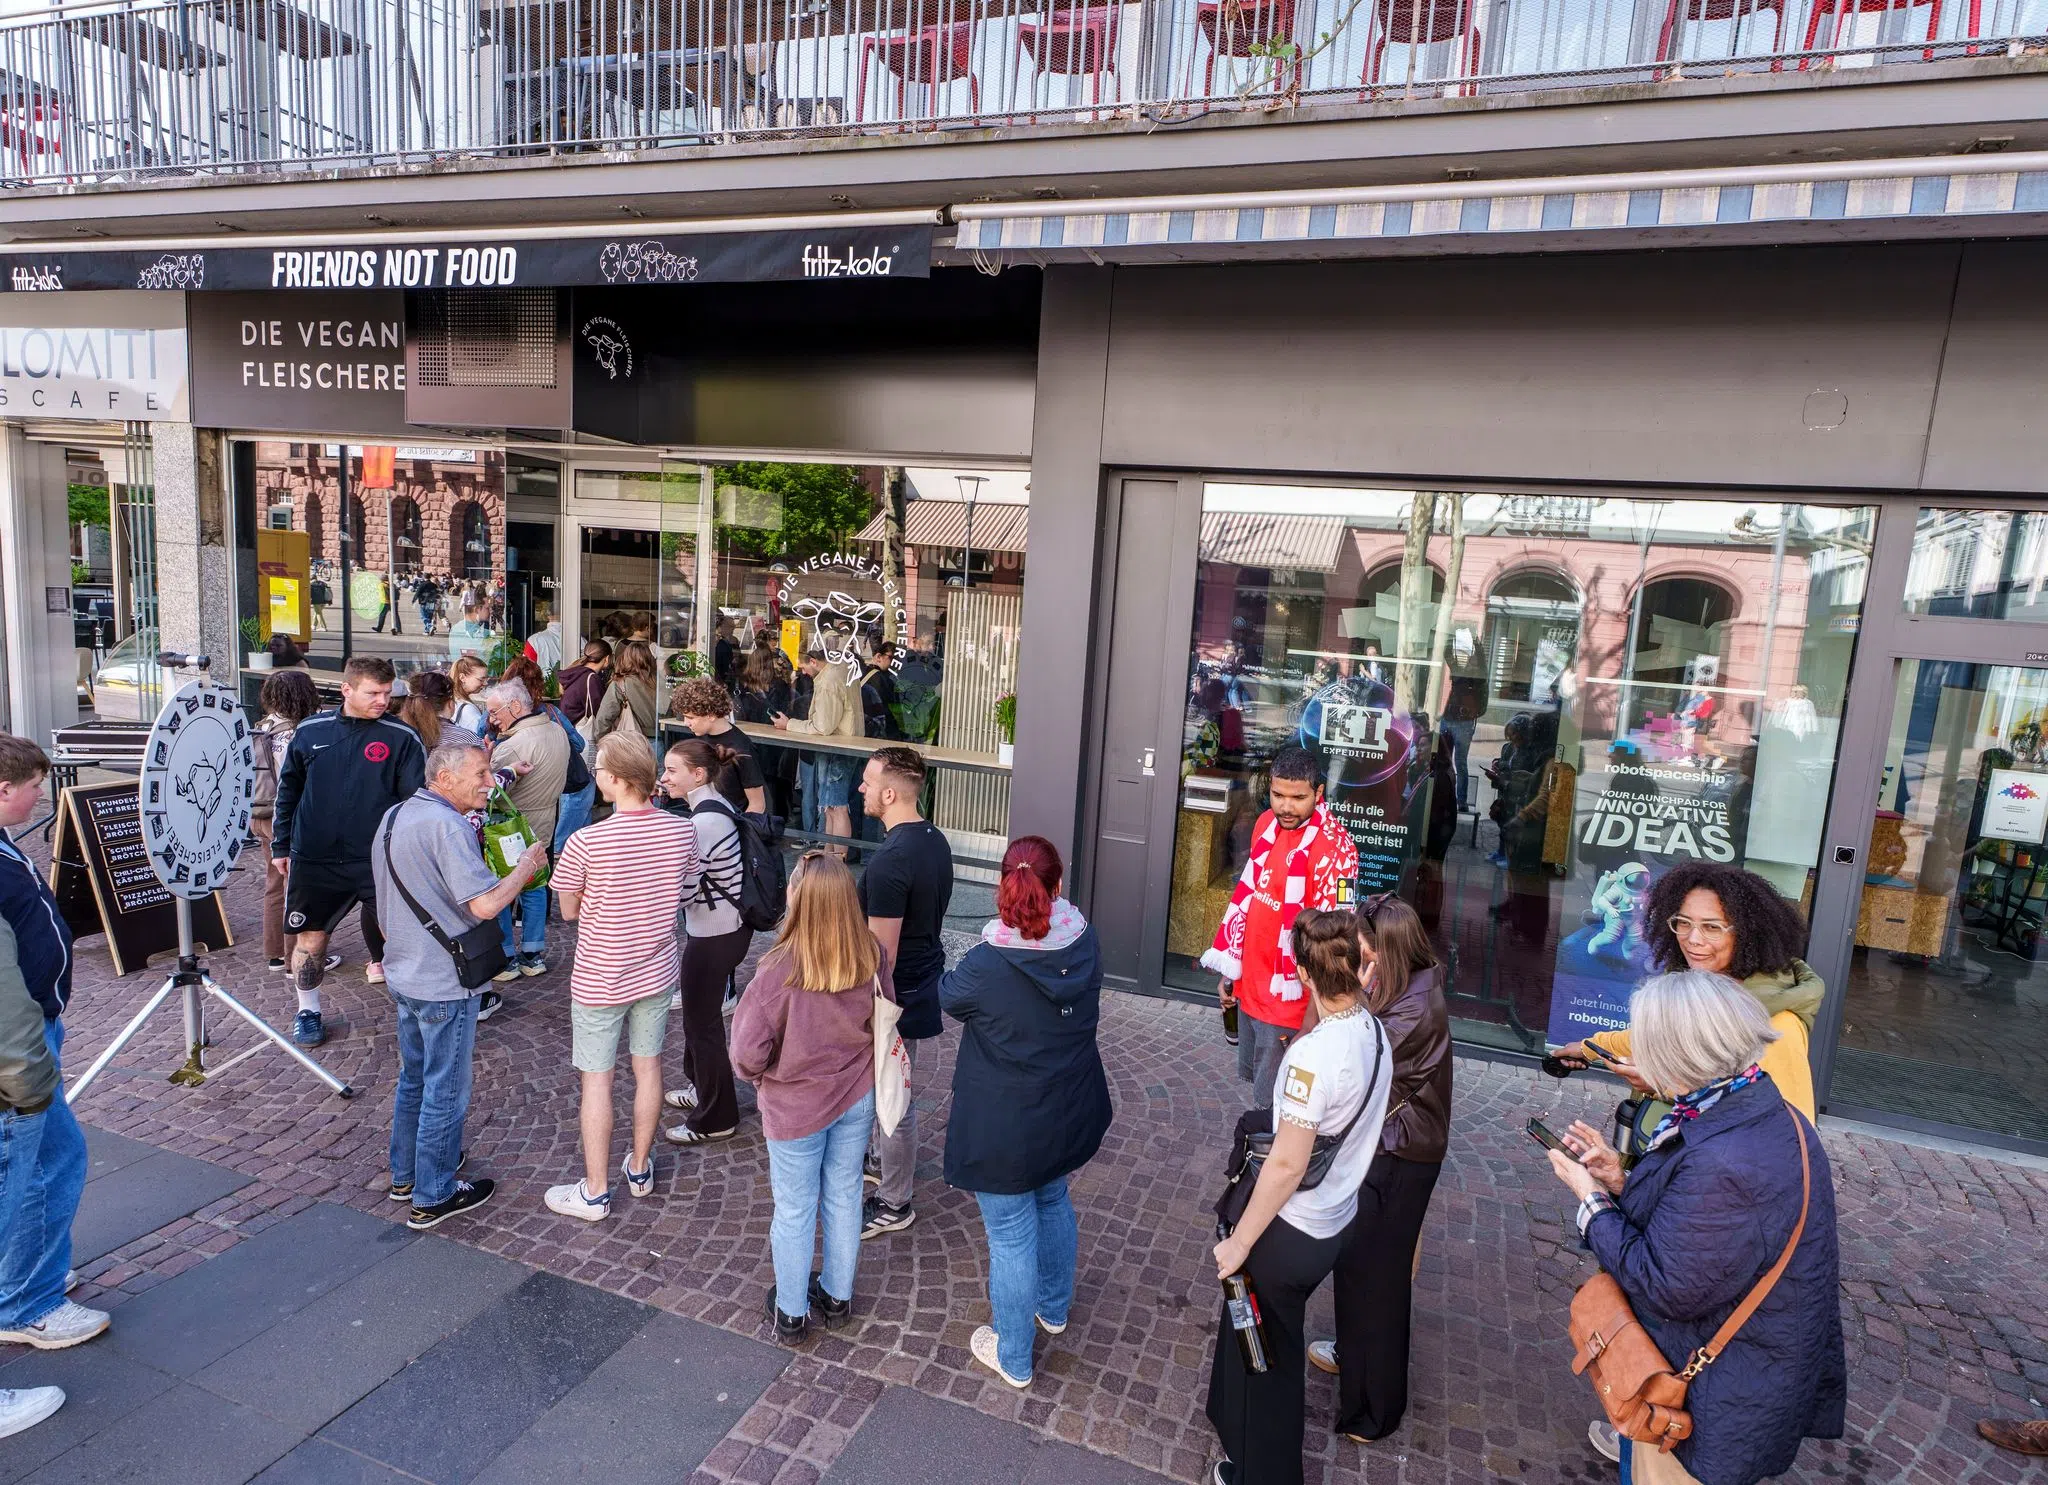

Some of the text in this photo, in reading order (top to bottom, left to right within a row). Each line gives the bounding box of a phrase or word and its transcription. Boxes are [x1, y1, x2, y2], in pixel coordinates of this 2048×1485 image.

[271, 247, 517, 288] FRIENDS NOT FOOD
[802, 245, 892, 277] fritz-kola
[12, 265, 64, 291] fritz-kola
[241, 320, 283, 347] DIE
[581, 322, 591, 336] DIE
[589, 316, 617, 329] VEGANE
[777, 551, 908, 677] DIE VEGANE FLEISCHEREI
[230, 740, 240, 766] DIE
[1322, 746, 1384, 761] EXPEDITION
[1604, 762, 1726, 785] robotspaceship
[222, 772, 241, 840] VEGANE
[1353, 803, 1364, 815] in
[1365, 805, 1384, 817] die
[1600, 789, 1727, 810] YOUR LAUNCHPAD FOR
[98, 807, 113, 815] MIT
[1594, 797, 1730, 826] INNOVATIVE
[1350, 818, 1369, 830] mit
[1371, 821, 1408, 835] einem
[1582, 812, 1736, 863] IDEAS
[166, 825, 222, 865] FLEISCHEREI
[1384, 836, 1402, 849] ist!
[1359, 878, 1383, 888] Arbeit.
[1364, 870, 1399, 881] und nutzt
[125, 893, 170, 907] BRÖTCHEN
[1570, 996, 1598, 1009] Jetzt
